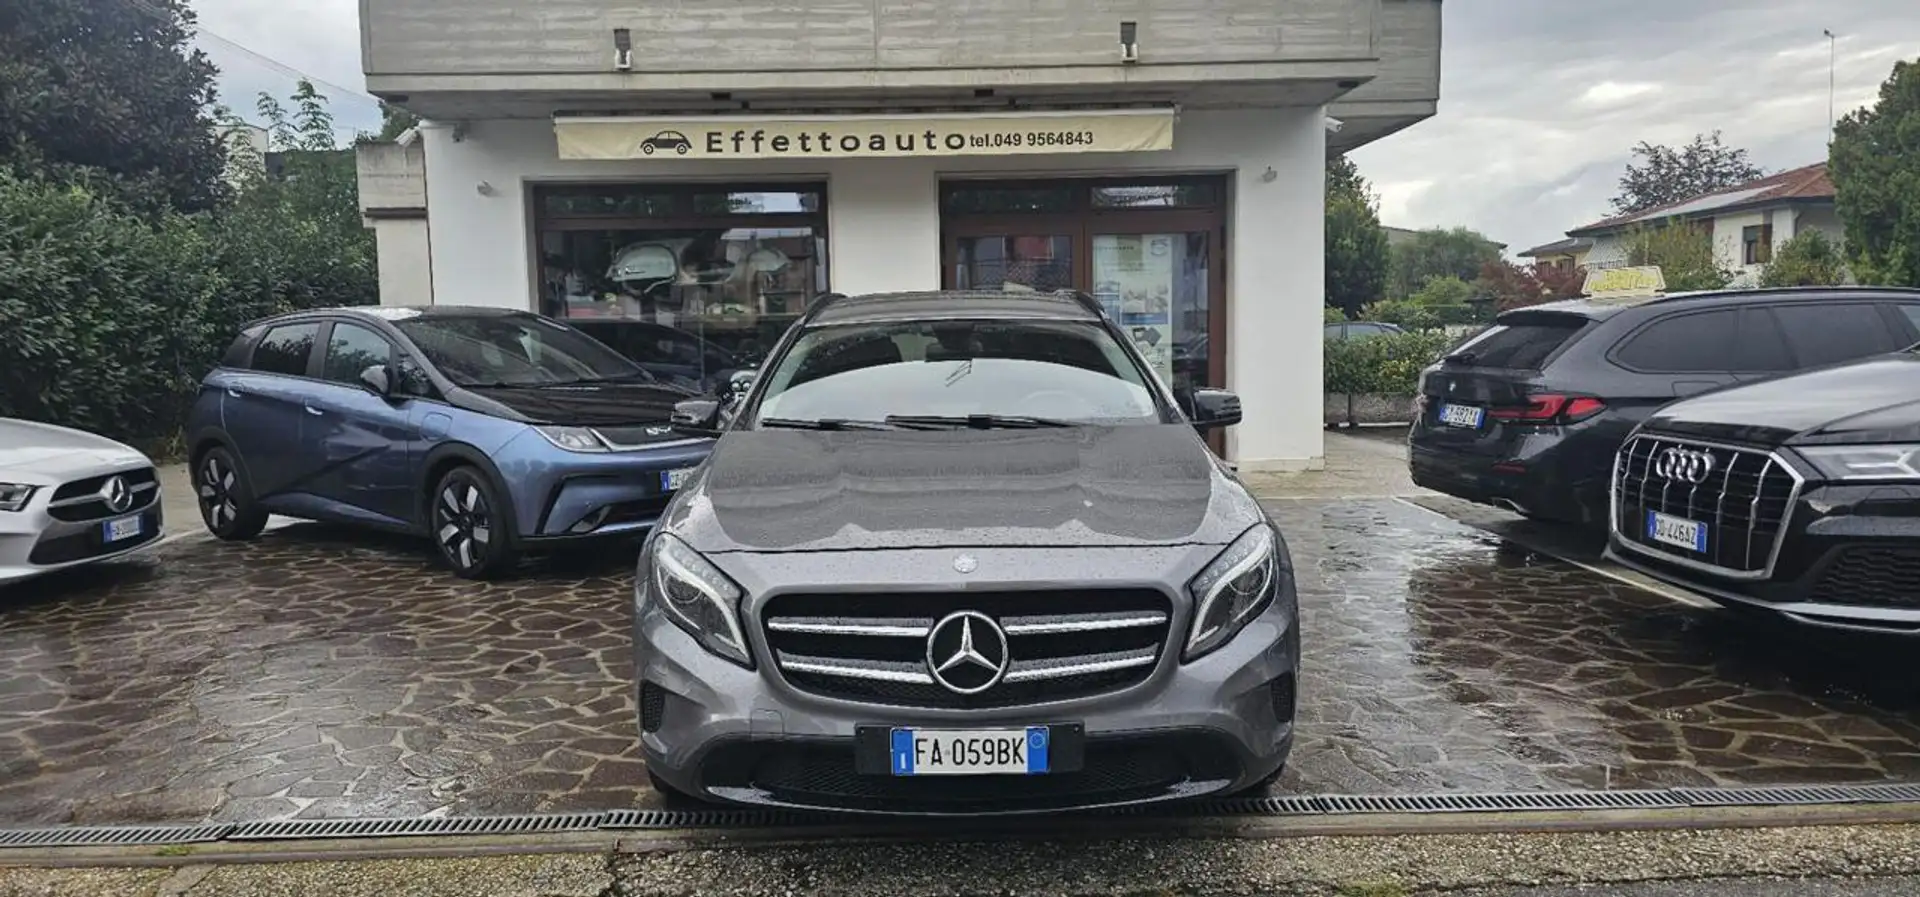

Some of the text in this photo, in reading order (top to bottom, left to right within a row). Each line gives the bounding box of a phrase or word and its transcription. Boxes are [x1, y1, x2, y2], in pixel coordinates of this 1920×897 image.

[706, 130, 1094, 153] Effettoauto tel.049 9564843
[915, 738, 943, 766] FA
[952, 737, 1026, 766] 059BK
